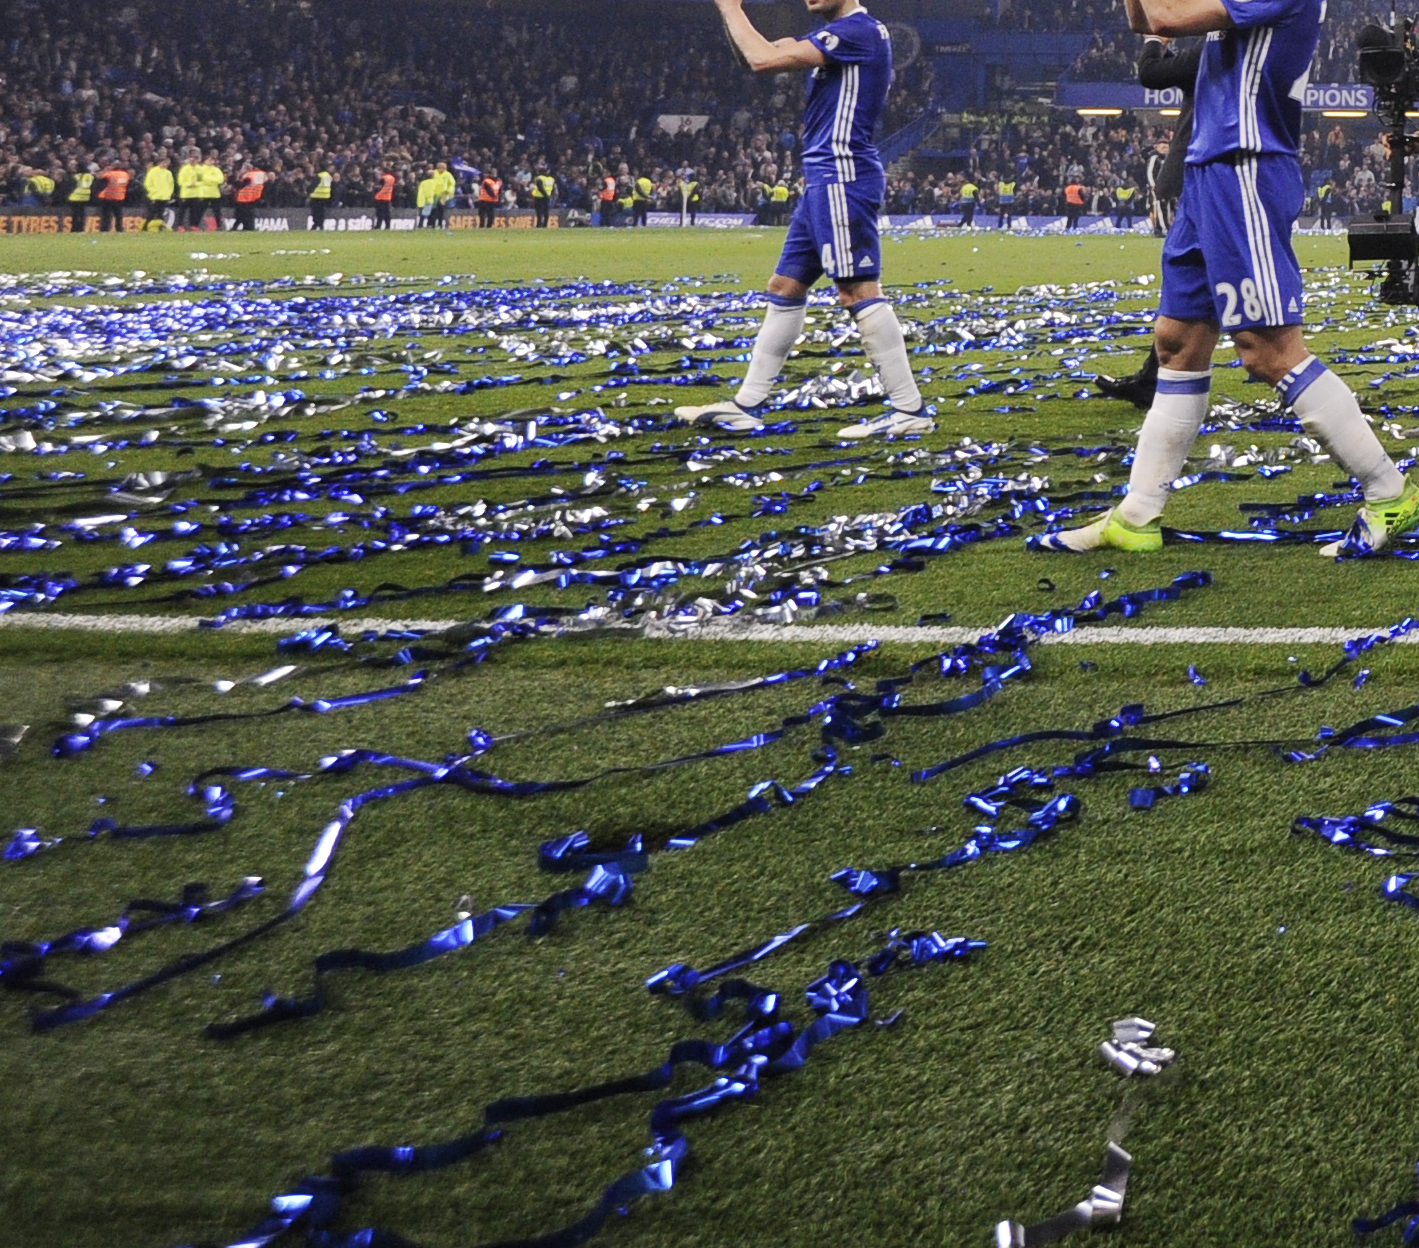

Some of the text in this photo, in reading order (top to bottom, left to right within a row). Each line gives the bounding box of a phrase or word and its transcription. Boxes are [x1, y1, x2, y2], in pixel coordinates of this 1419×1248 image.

[1306, 89, 1367, 106] PIONS
[11, 215, 58, 233] TYRES
[338, 218, 346, 231] a
[348, 215, 373, 231] safe
[449, 215, 474, 229] SAFE
[1215, 278, 1264, 327] 28
